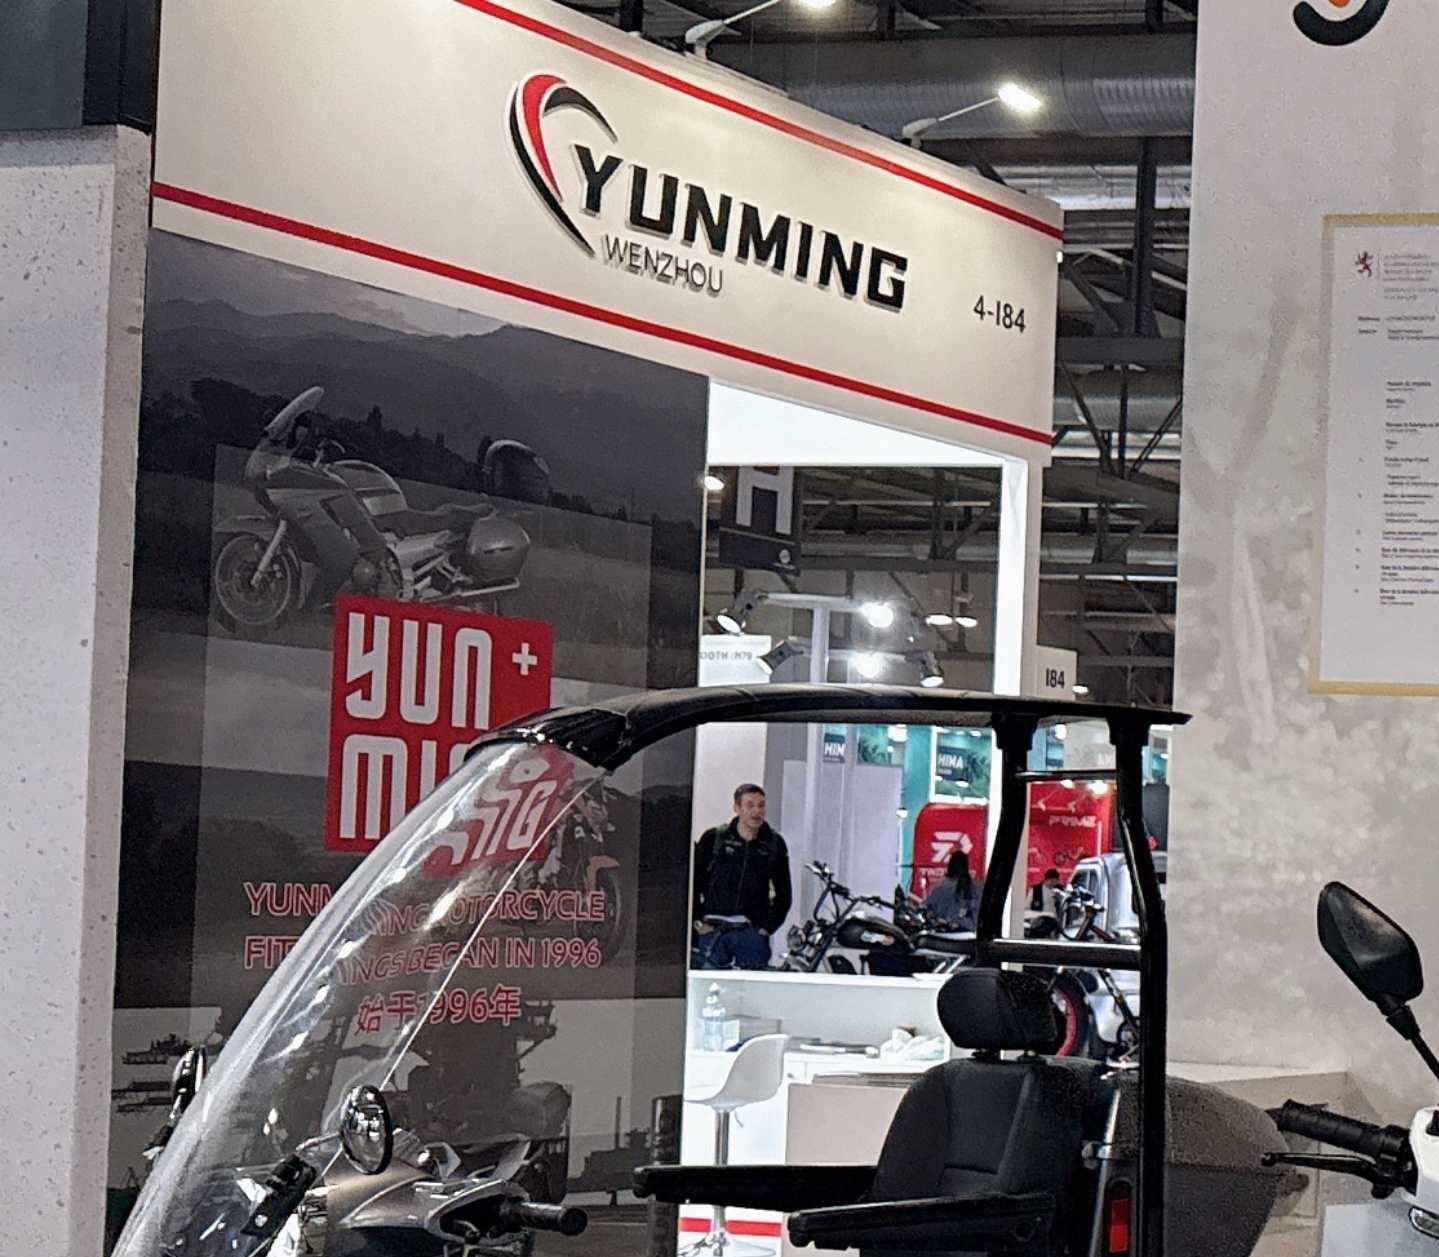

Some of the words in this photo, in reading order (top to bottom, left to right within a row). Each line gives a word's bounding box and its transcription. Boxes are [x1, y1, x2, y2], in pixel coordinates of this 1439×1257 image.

[574, 143, 908, 311] YUNMING
[602, 233, 724, 295] WENZHOU
[432, 890, 606, 922] OTORCYCLE
[505, 938, 536, 968] IN
[541, 937, 602, 969] 1996
